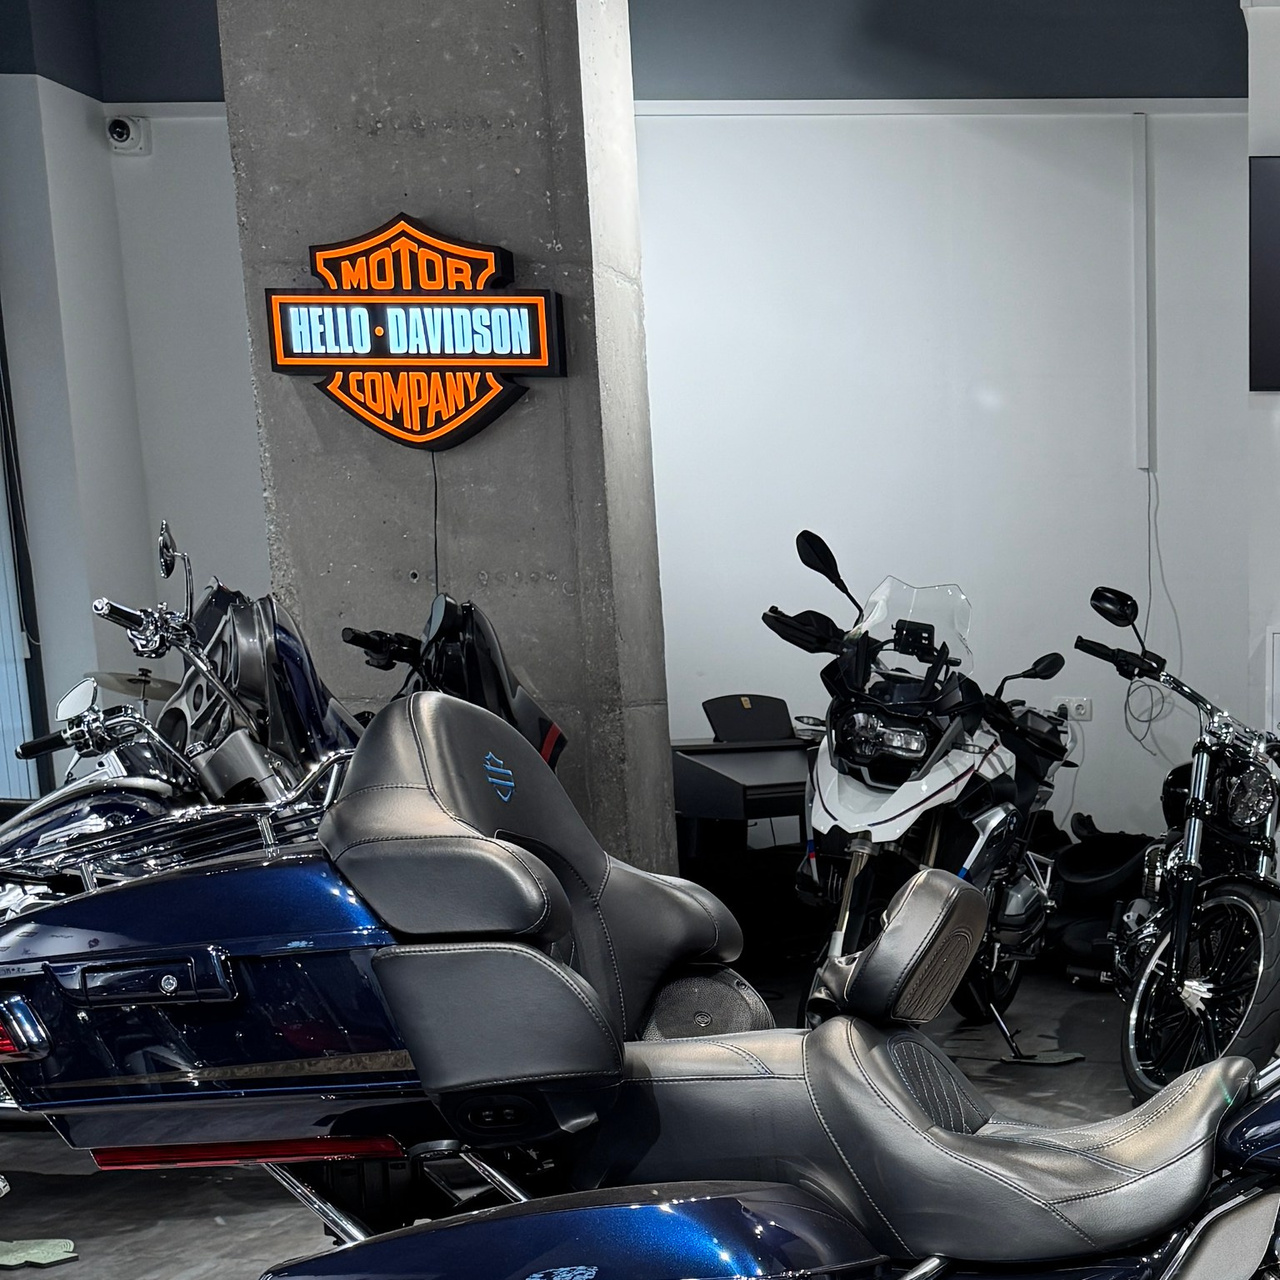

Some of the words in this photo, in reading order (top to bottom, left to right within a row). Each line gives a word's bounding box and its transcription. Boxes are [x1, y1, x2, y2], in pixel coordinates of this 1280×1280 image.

[340, 237, 473, 291] MOTOR
[289, 307, 372, 354] HELLO
[386, 307, 531, 354] DAVIDSON
[349, 371, 481, 431] COMPANY
